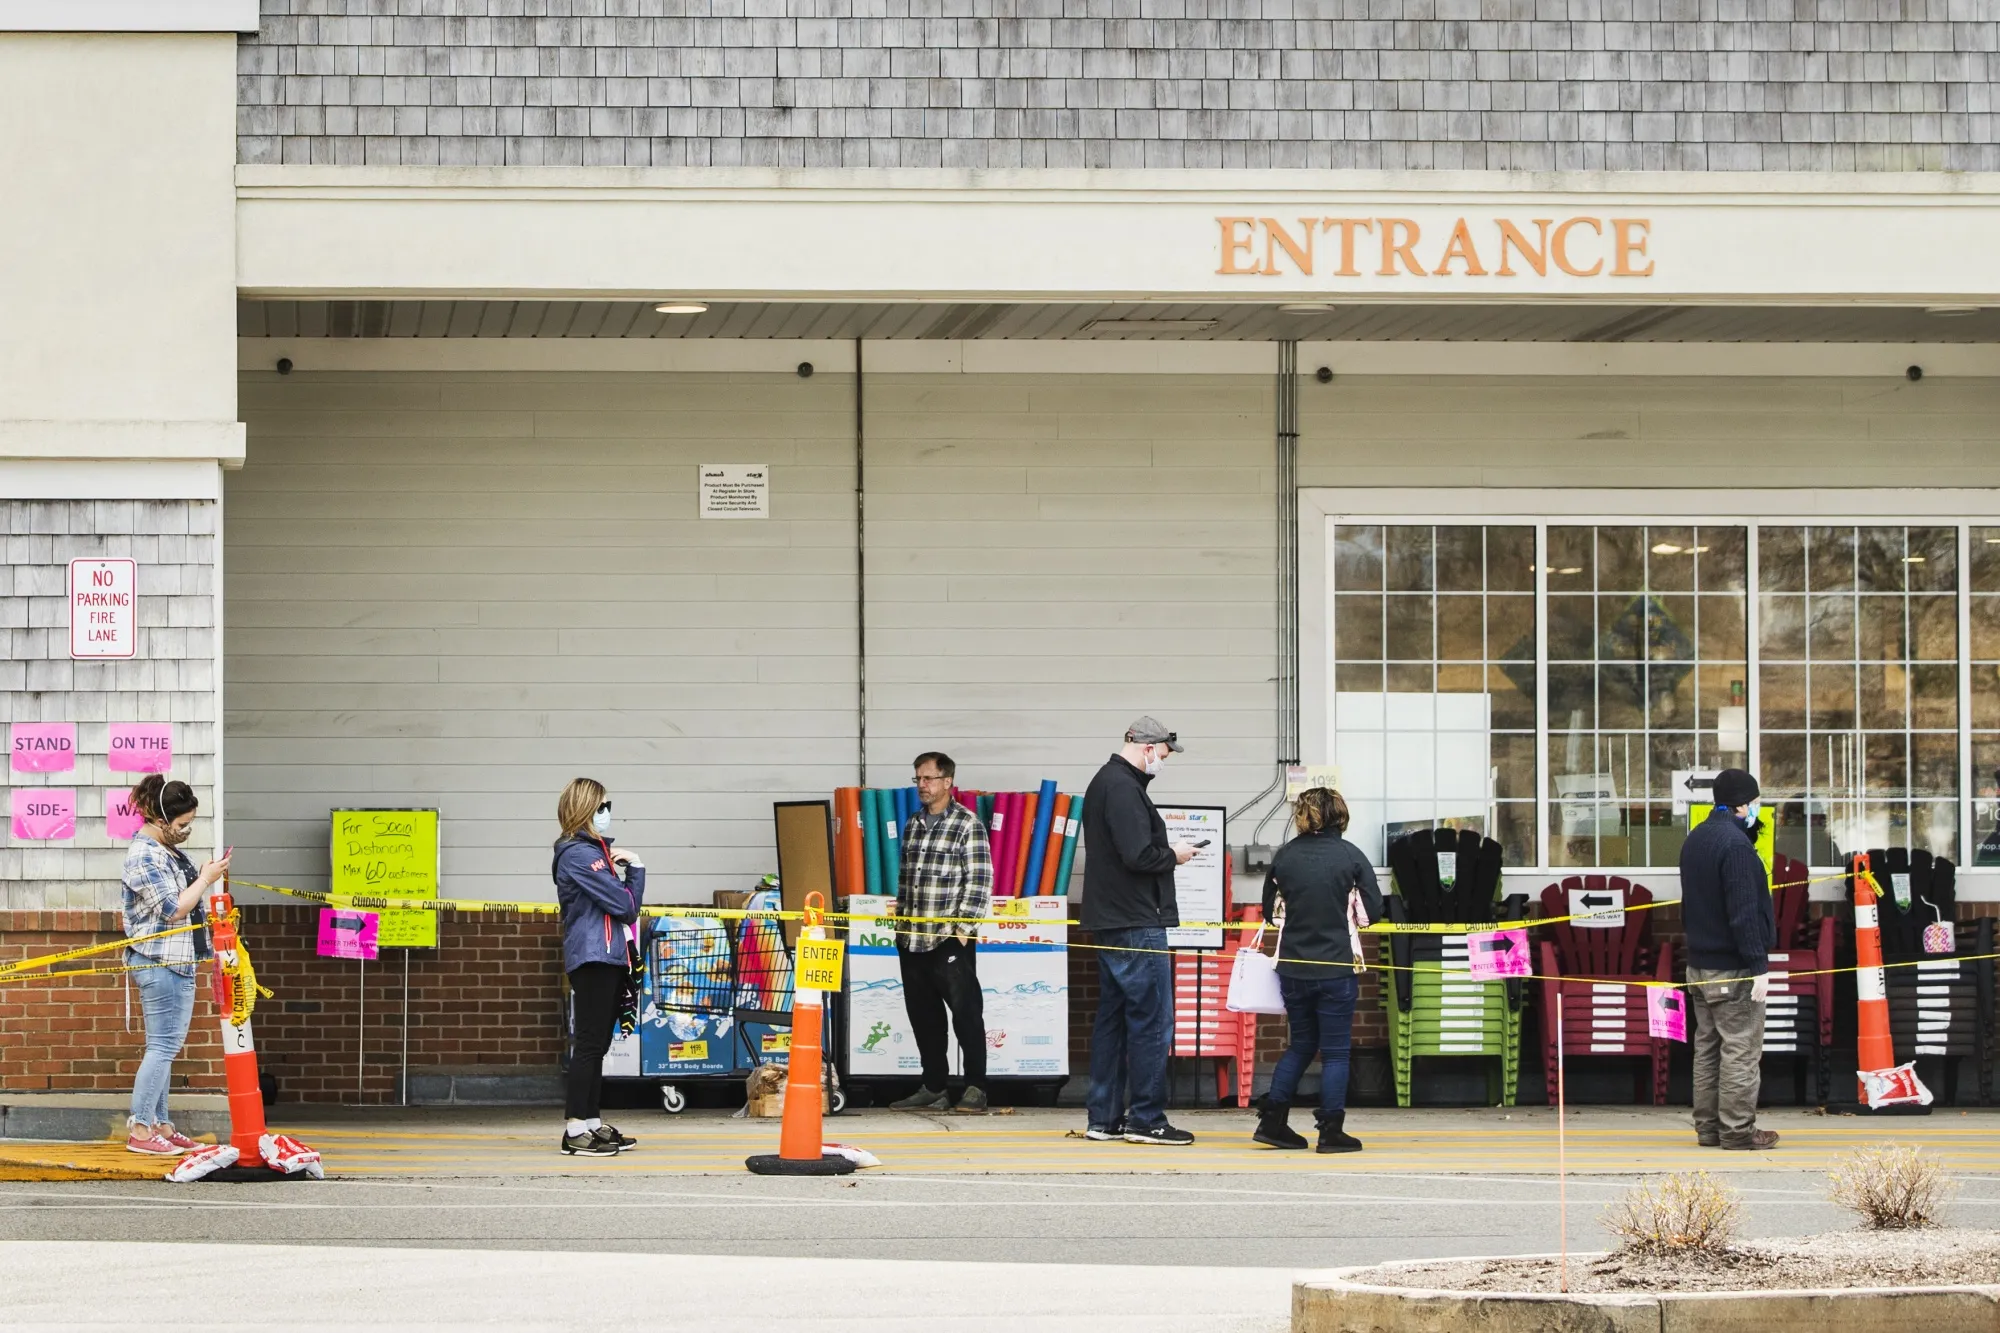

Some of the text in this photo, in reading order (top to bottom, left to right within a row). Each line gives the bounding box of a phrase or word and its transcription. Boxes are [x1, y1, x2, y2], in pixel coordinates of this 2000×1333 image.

[1214, 216, 1655, 277] ENTRANCE
[93, 570, 113, 586] NO
[77, 593, 129, 606] PARKING
[90, 612, 116, 623] FIRE
[88, 630, 117, 641] LANE
[15, 737, 71, 751] STAND
[112, 737, 169, 750] ON THE
[26, 804, 68, 816] SIDE-
[116, 804, 142, 816] WA
[343, 816, 417, 836] For Social
[346, 841, 414, 860] Distancing
[366, 862, 386, 880] 60
[388, 867, 428, 879] customers
[292, 889, 518, 913] CAUTION CUIDADO CAUTION CUIDADO
[1396, 923, 1499, 931] CUIDADO CAUTION
[803, 947, 838, 960] ENTER
[1474, 960, 1526, 971] ENTER THIS WAY
[806, 970, 833, 983] HERE
[234, 974, 244, 1012] CAUTION
